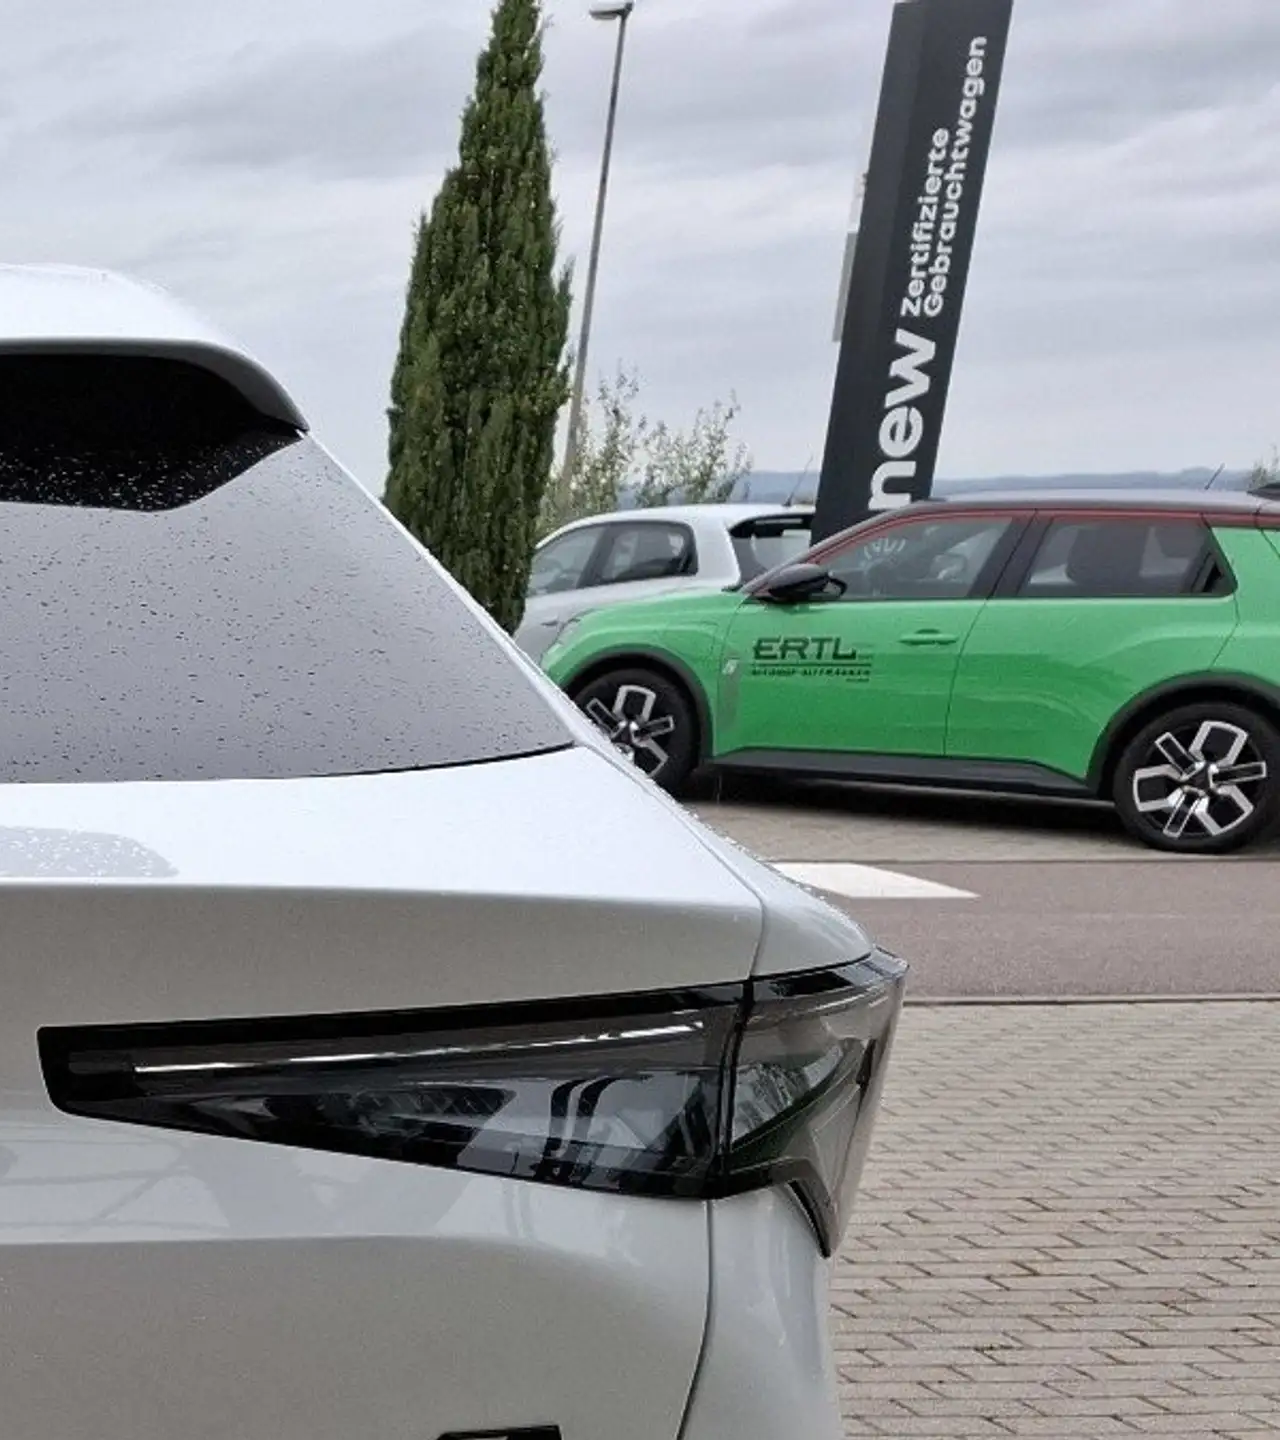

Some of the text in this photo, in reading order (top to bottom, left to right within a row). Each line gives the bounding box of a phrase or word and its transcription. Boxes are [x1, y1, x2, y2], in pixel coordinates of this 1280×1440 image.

[900, 128, 949, 317] Zertifizierte
[923, 36, 987, 318] Gebrauchtwagen
[753, 637, 856, 660] ERTL
